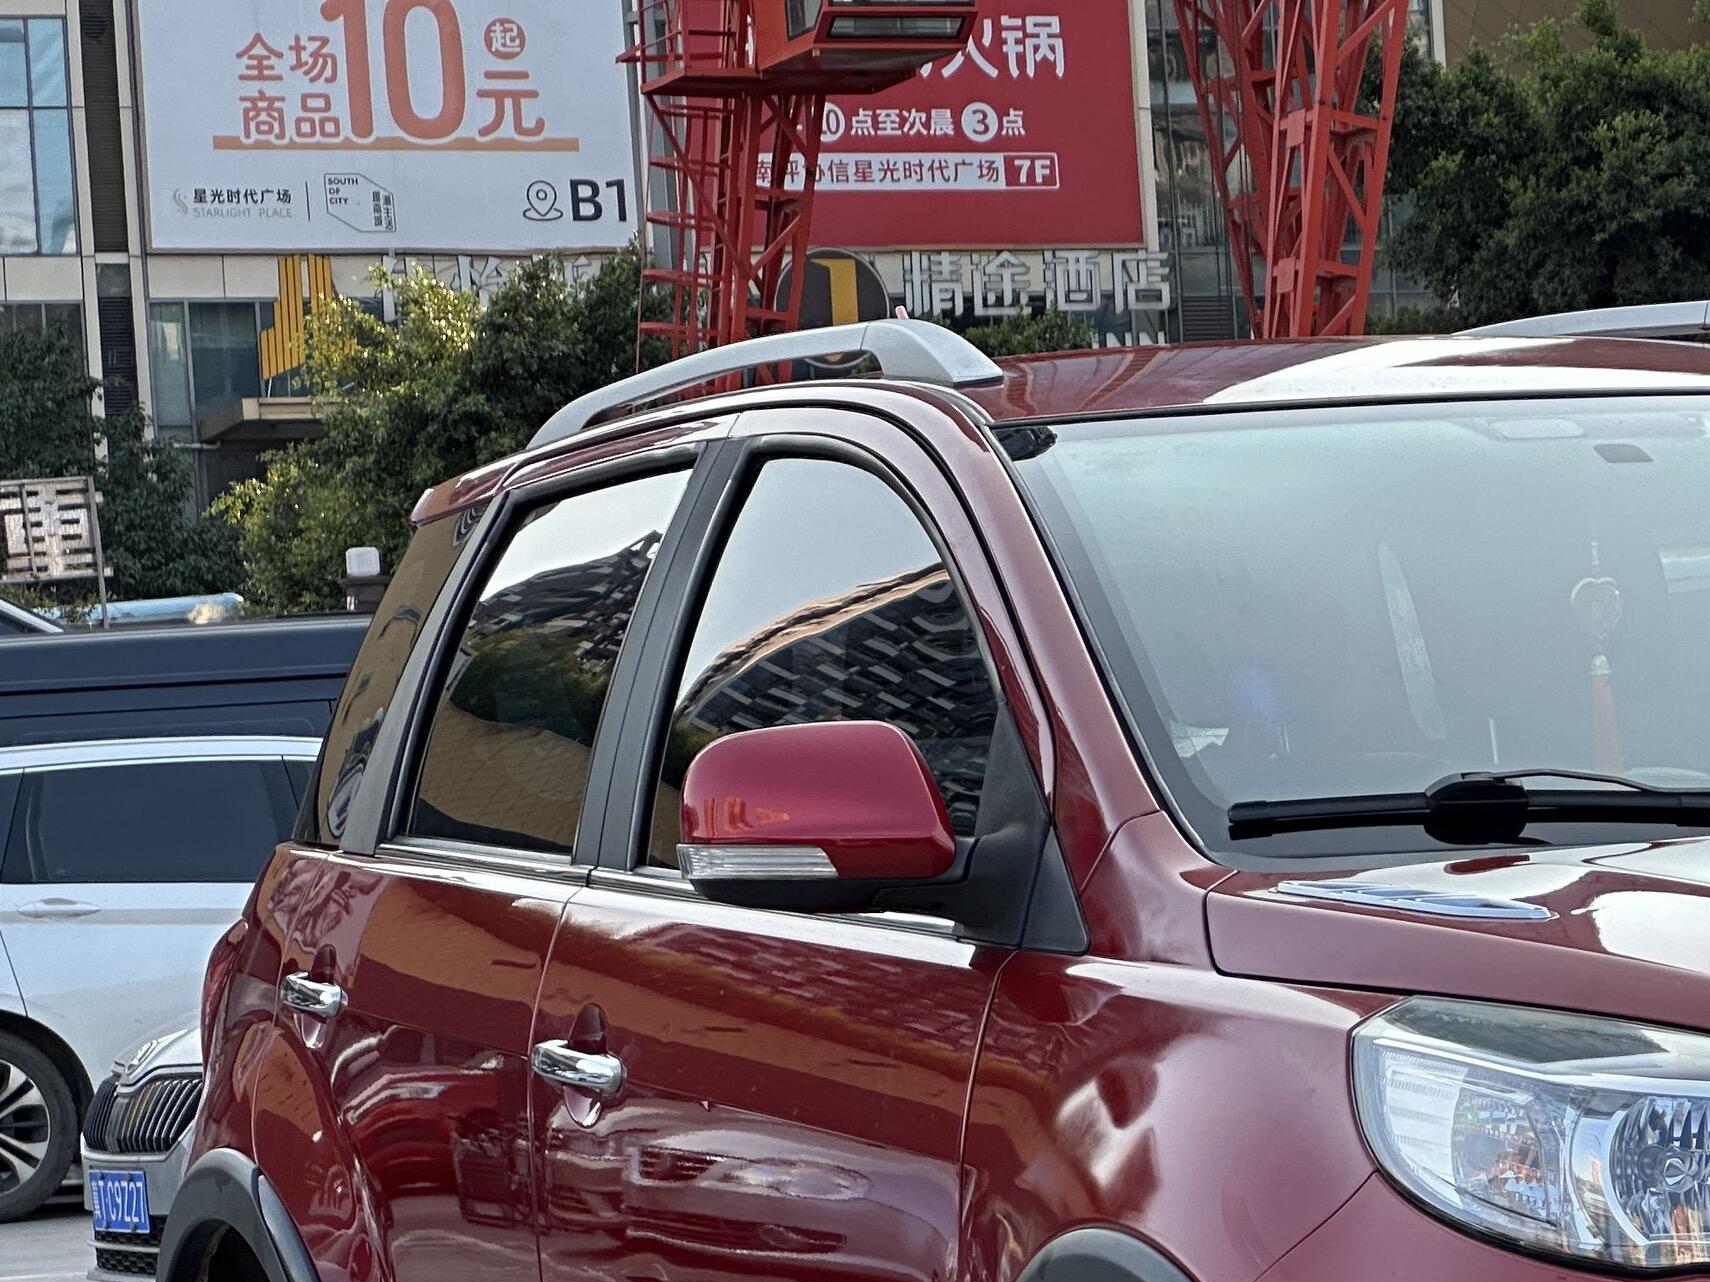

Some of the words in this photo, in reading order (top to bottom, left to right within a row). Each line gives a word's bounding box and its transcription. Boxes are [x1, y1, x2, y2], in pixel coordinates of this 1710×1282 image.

[490, 22, 522, 52] 起
[919, 14, 1065, 79] 火锅
[236, 32, 338, 83] 全场
[239, 89, 342, 140] 商品
[476, 70, 545, 138] 元
[327, 177, 358, 186] SOUTH
[1013, 158, 1051, 184] 7F
[193, 188, 292, 205] 星光时代广场
[329, 187, 341, 195] OF
[329, 196, 348, 206] CITY
[569, 178, 628, 222] B1
[193, 207, 250, 218] STARLIGHT
[259, 207, 293, 218] PLACE
[903, 250, 1171, 317] 精途酒店
